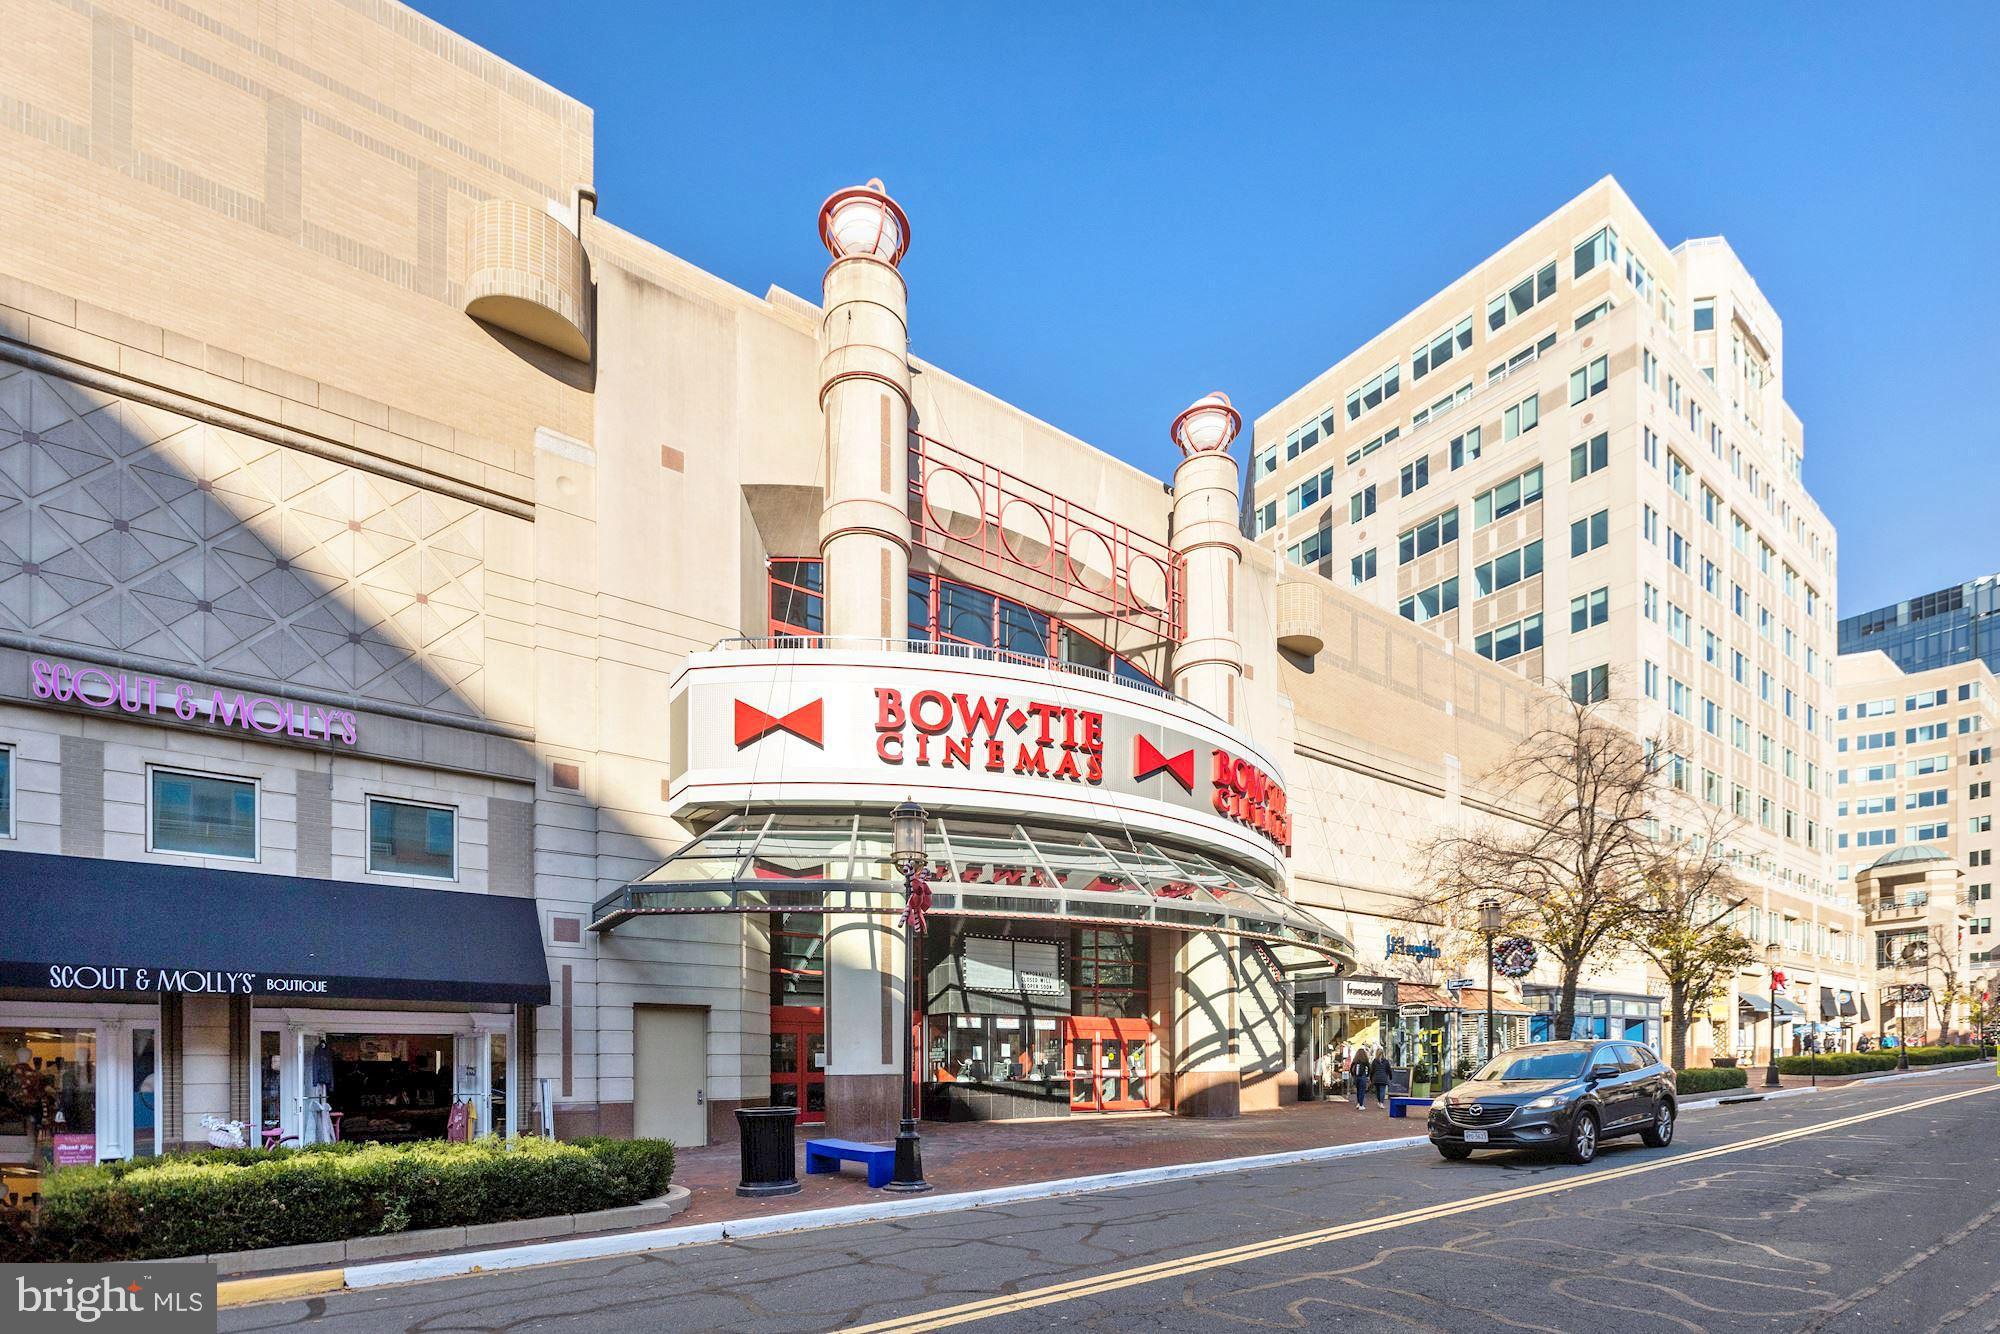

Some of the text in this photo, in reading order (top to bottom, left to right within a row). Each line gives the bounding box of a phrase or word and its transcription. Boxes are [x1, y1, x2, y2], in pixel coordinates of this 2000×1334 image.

[32, 659, 358, 745] SCOUT & MOLLY'S
[874, 687, 1104, 755] BOW TIE
[876, 731, 1104, 787] CINEMAS
[49, 965, 254, 994] SCOUT & MOLLY'S
[266, 978, 328, 993] BOUTIQUE
